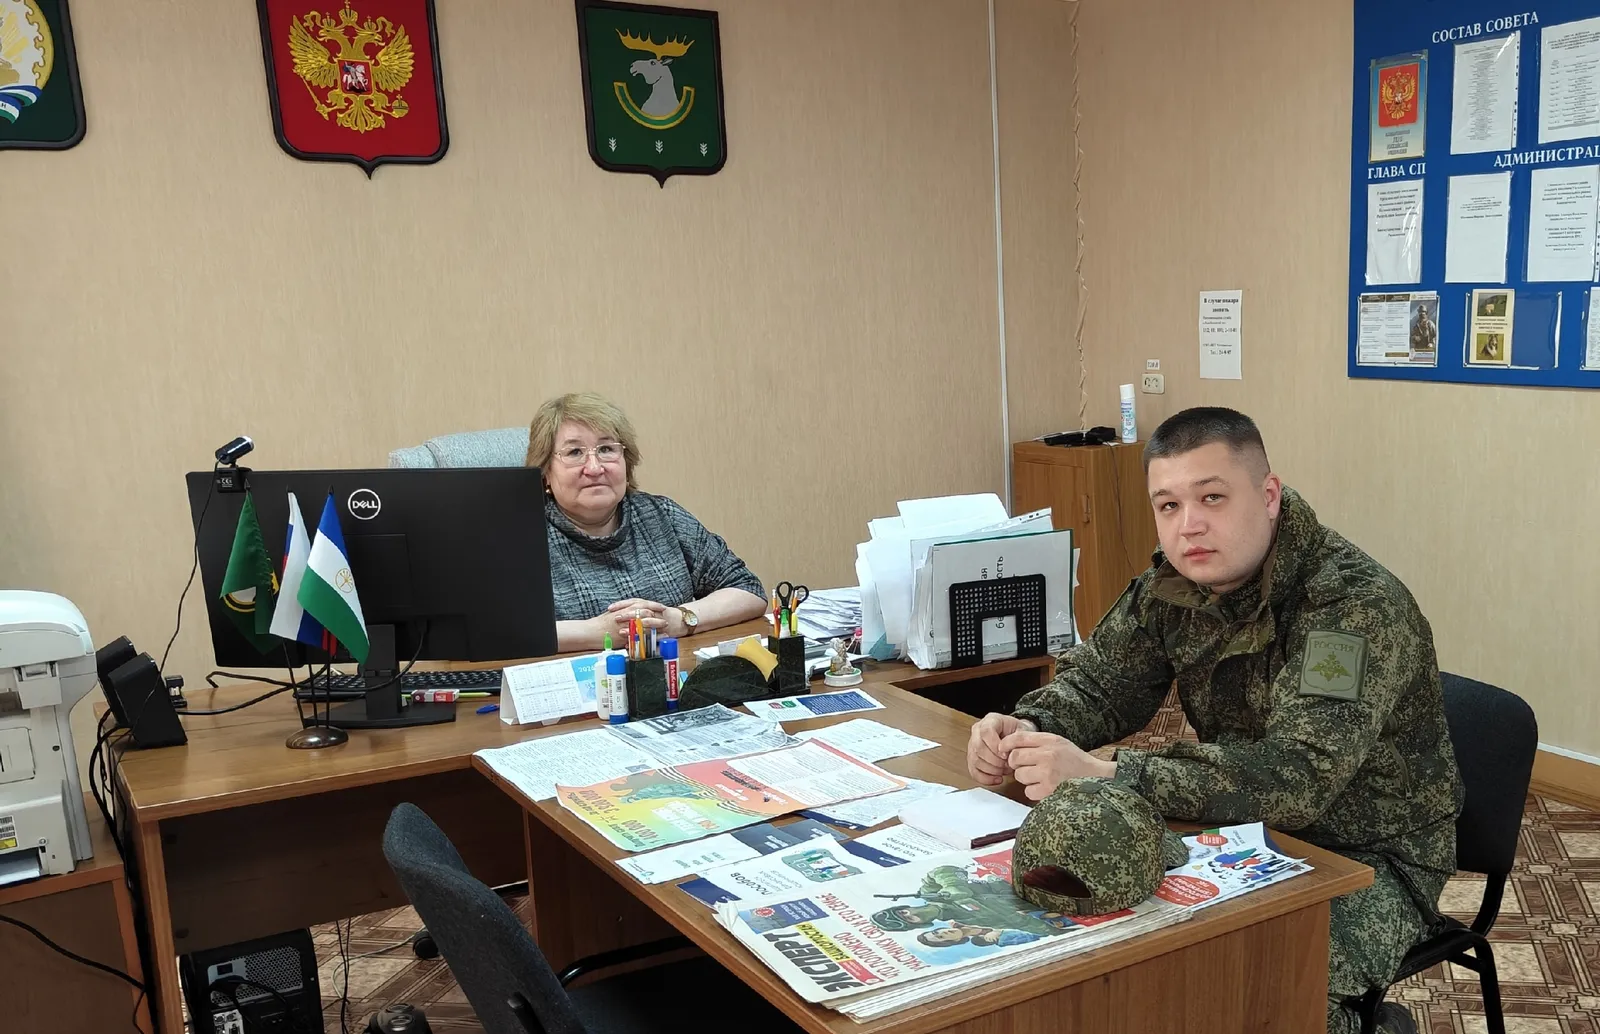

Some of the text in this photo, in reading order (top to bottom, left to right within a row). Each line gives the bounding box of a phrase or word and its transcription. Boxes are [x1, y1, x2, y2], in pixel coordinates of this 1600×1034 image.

[1432, 11, 1539, 43] СОСТАВ СОВЕТА
[1368, 162, 1427, 179] ГЛАВА СП
[352, 500, 378, 509] DELL
[1314, 640, 1355, 653] РОССИЯ
[763, 932, 865, 992] ЭКСПЕРТ
[833, 932, 889, 968] ПОЛОЖЕНО
